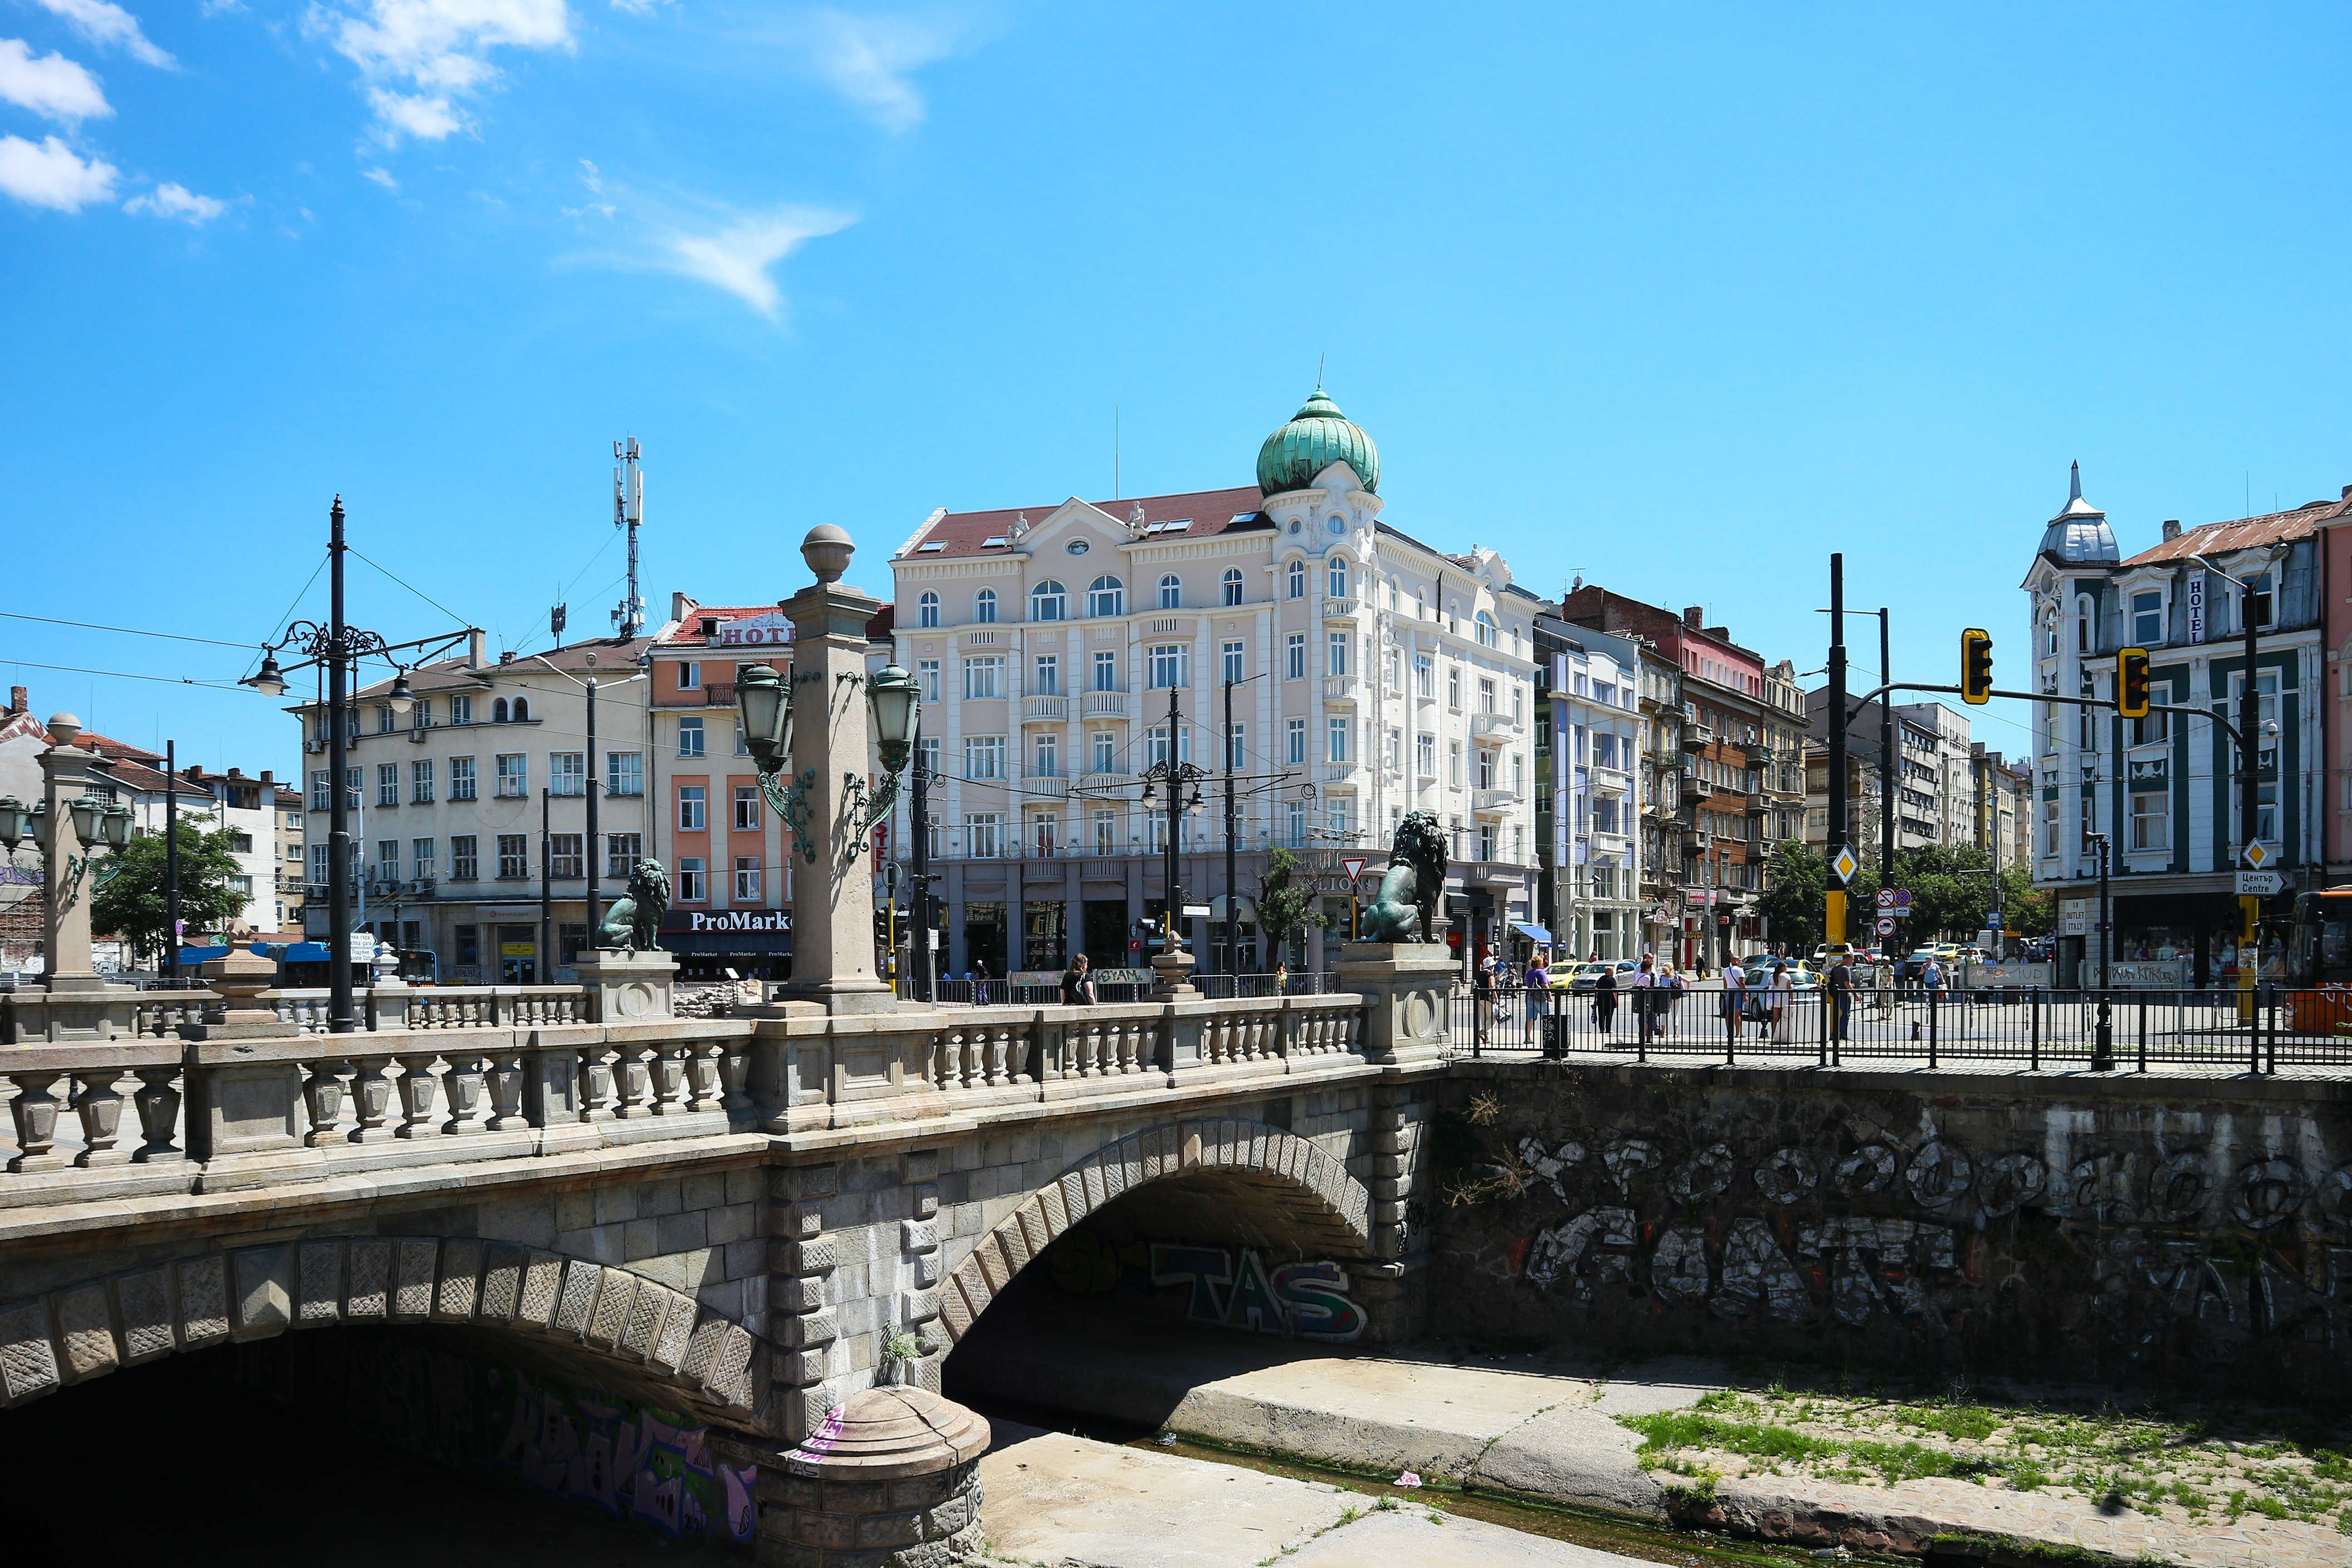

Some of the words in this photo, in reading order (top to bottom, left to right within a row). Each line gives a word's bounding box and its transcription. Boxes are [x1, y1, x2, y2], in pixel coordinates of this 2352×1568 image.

[723, 628, 796, 644] HOT
[2190, 581, 2202, 644] HOTEL
[1382, 613, 1393, 700] HOTEL
[1383, 720, 1394, 788] LION
[875, 822, 887, 872] STEL
[2243, 873, 2273, 883] Център
[2243, 884, 2269, 892] Centre
[691, 911, 792, 930] ProMark
[1150, 1243, 1368, 1343] TAS
